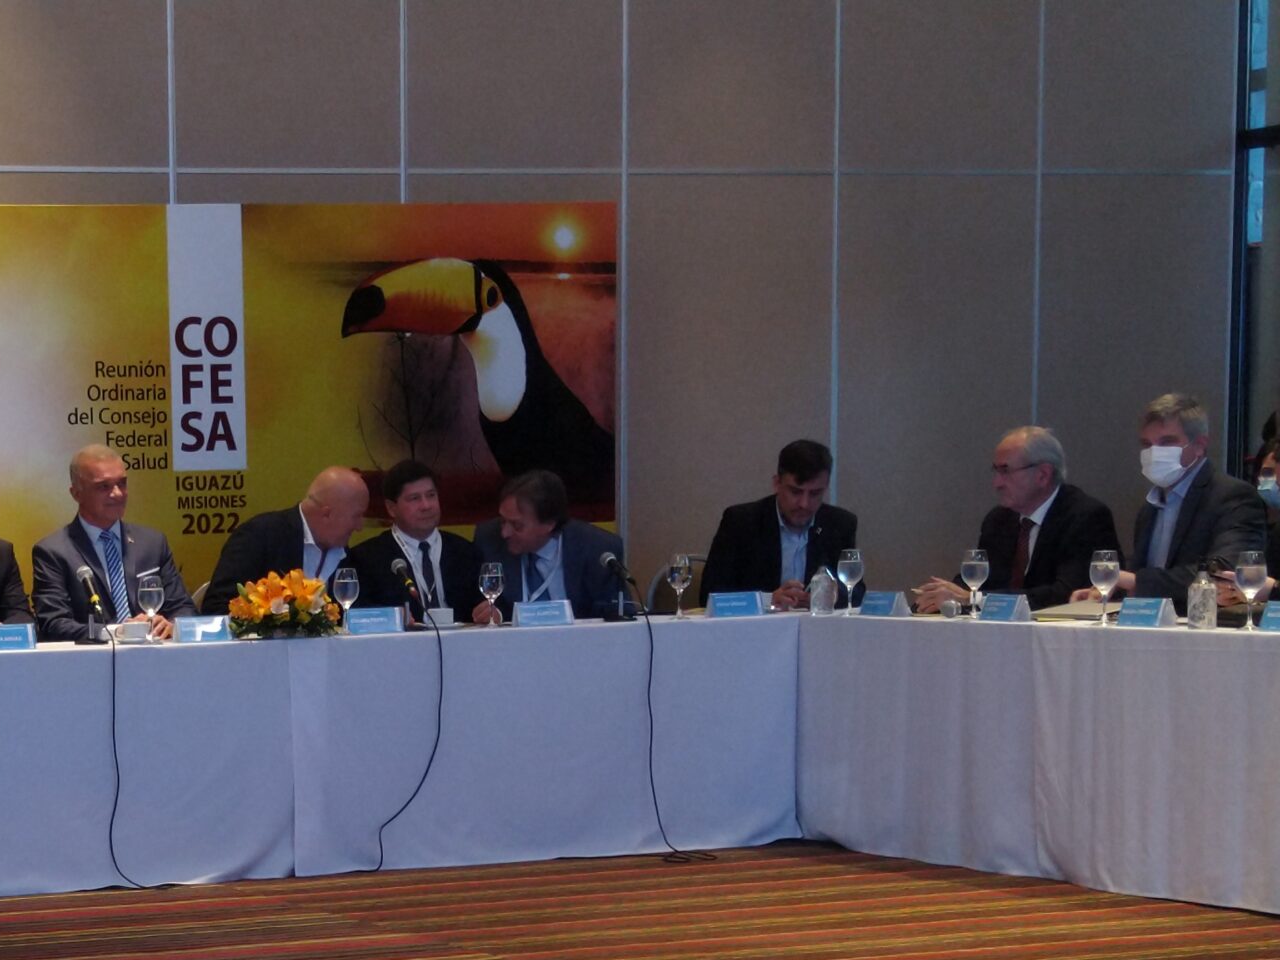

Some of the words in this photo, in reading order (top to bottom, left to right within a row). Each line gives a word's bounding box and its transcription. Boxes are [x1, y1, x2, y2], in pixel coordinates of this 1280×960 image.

[174, 315, 238, 358] CO
[95, 360, 166, 378] Reunión
[87, 384, 167, 402] Ordinaria
[181, 363, 234, 405] FE
[67, 407, 94, 426] del
[98, 407, 168, 429] Consejo
[105, 430, 168, 448] Federal
[180, 410, 238, 452] SA
[122, 453, 168, 471] Salud
[176, 471, 245, 492] IGUAZÚ
[177, 495, 247, 510] MISIONES
[182, 513, 241, 535] 2022
